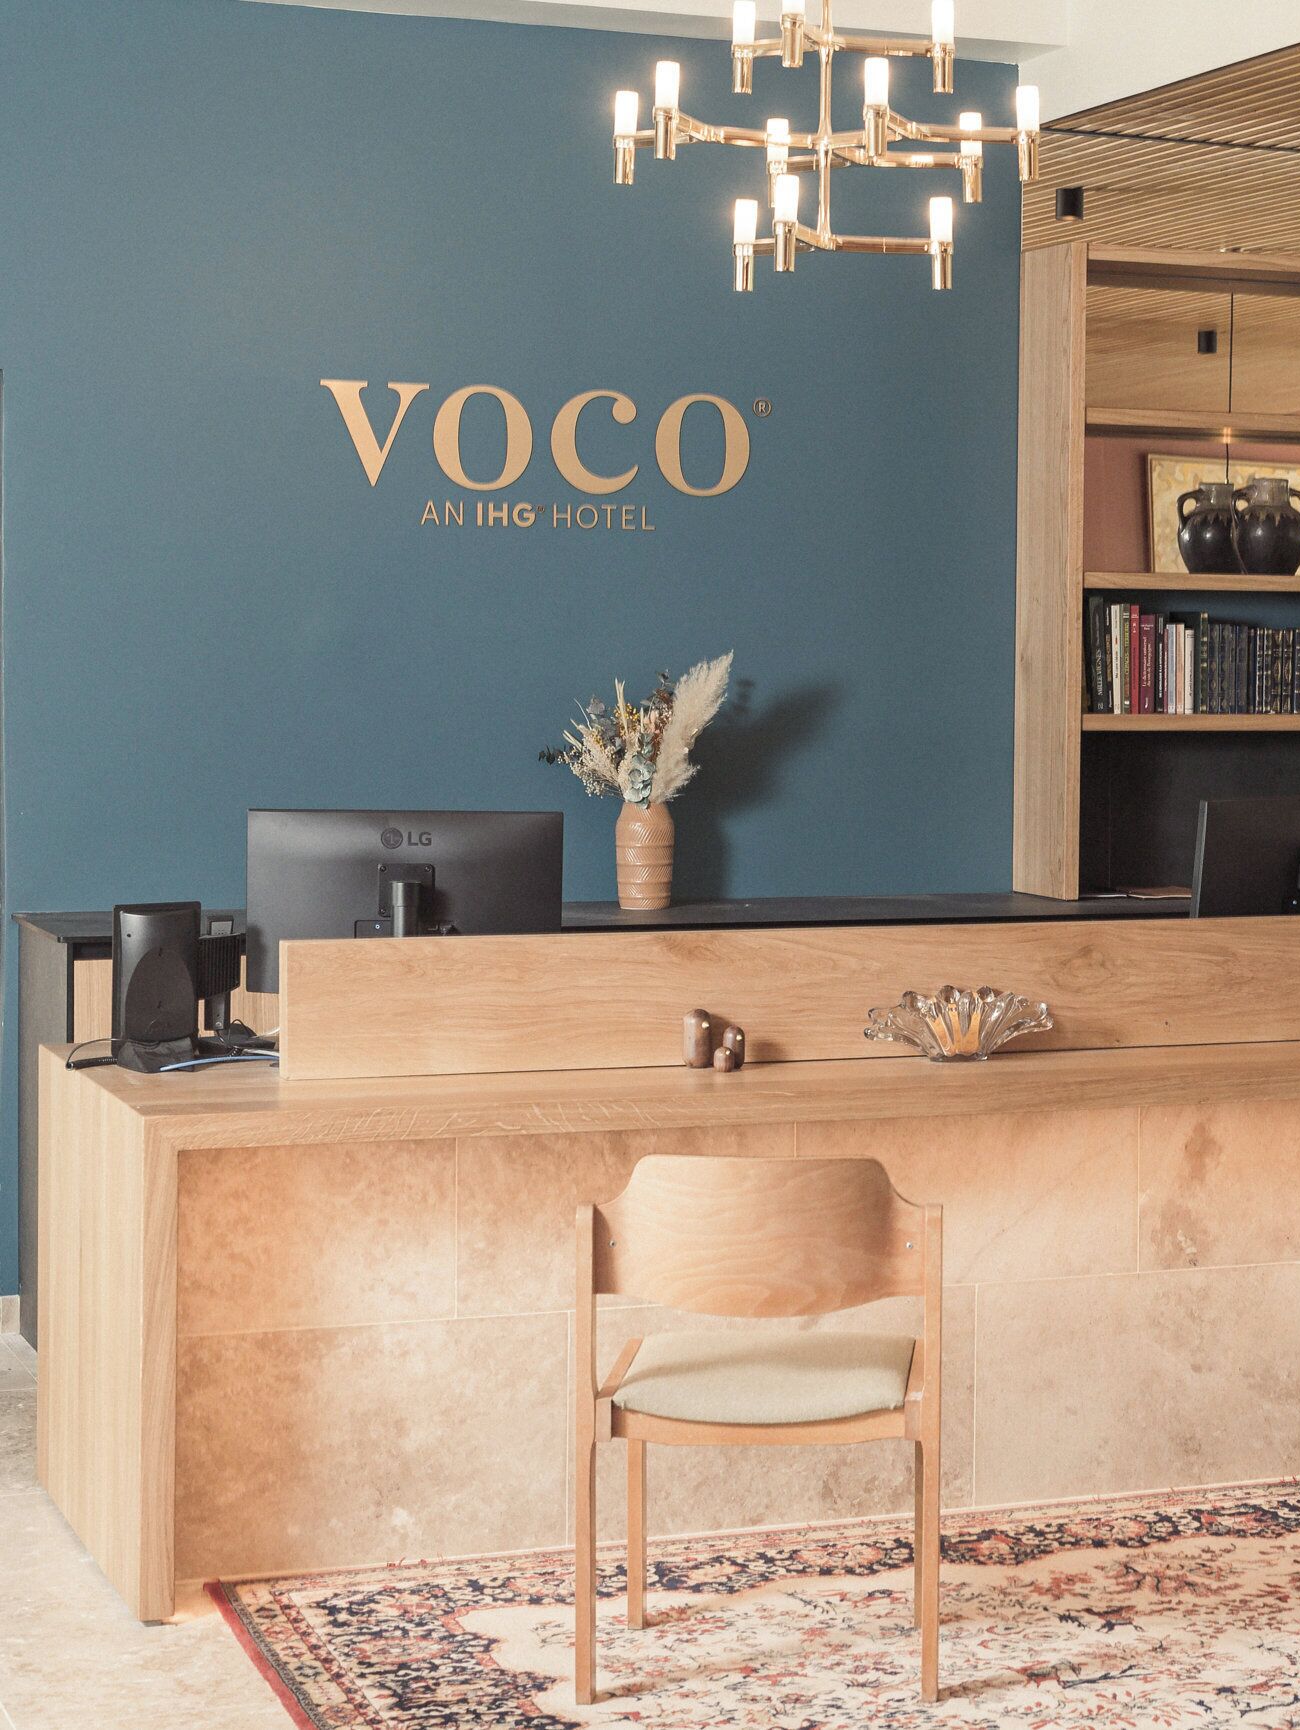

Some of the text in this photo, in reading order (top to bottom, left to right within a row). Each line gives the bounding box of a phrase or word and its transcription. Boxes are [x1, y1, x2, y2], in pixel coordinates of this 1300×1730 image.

[420, 499, 464, 527] AN
[553, 503, 657, 531] HOTEL
[407, 831, 432, 847] LG
